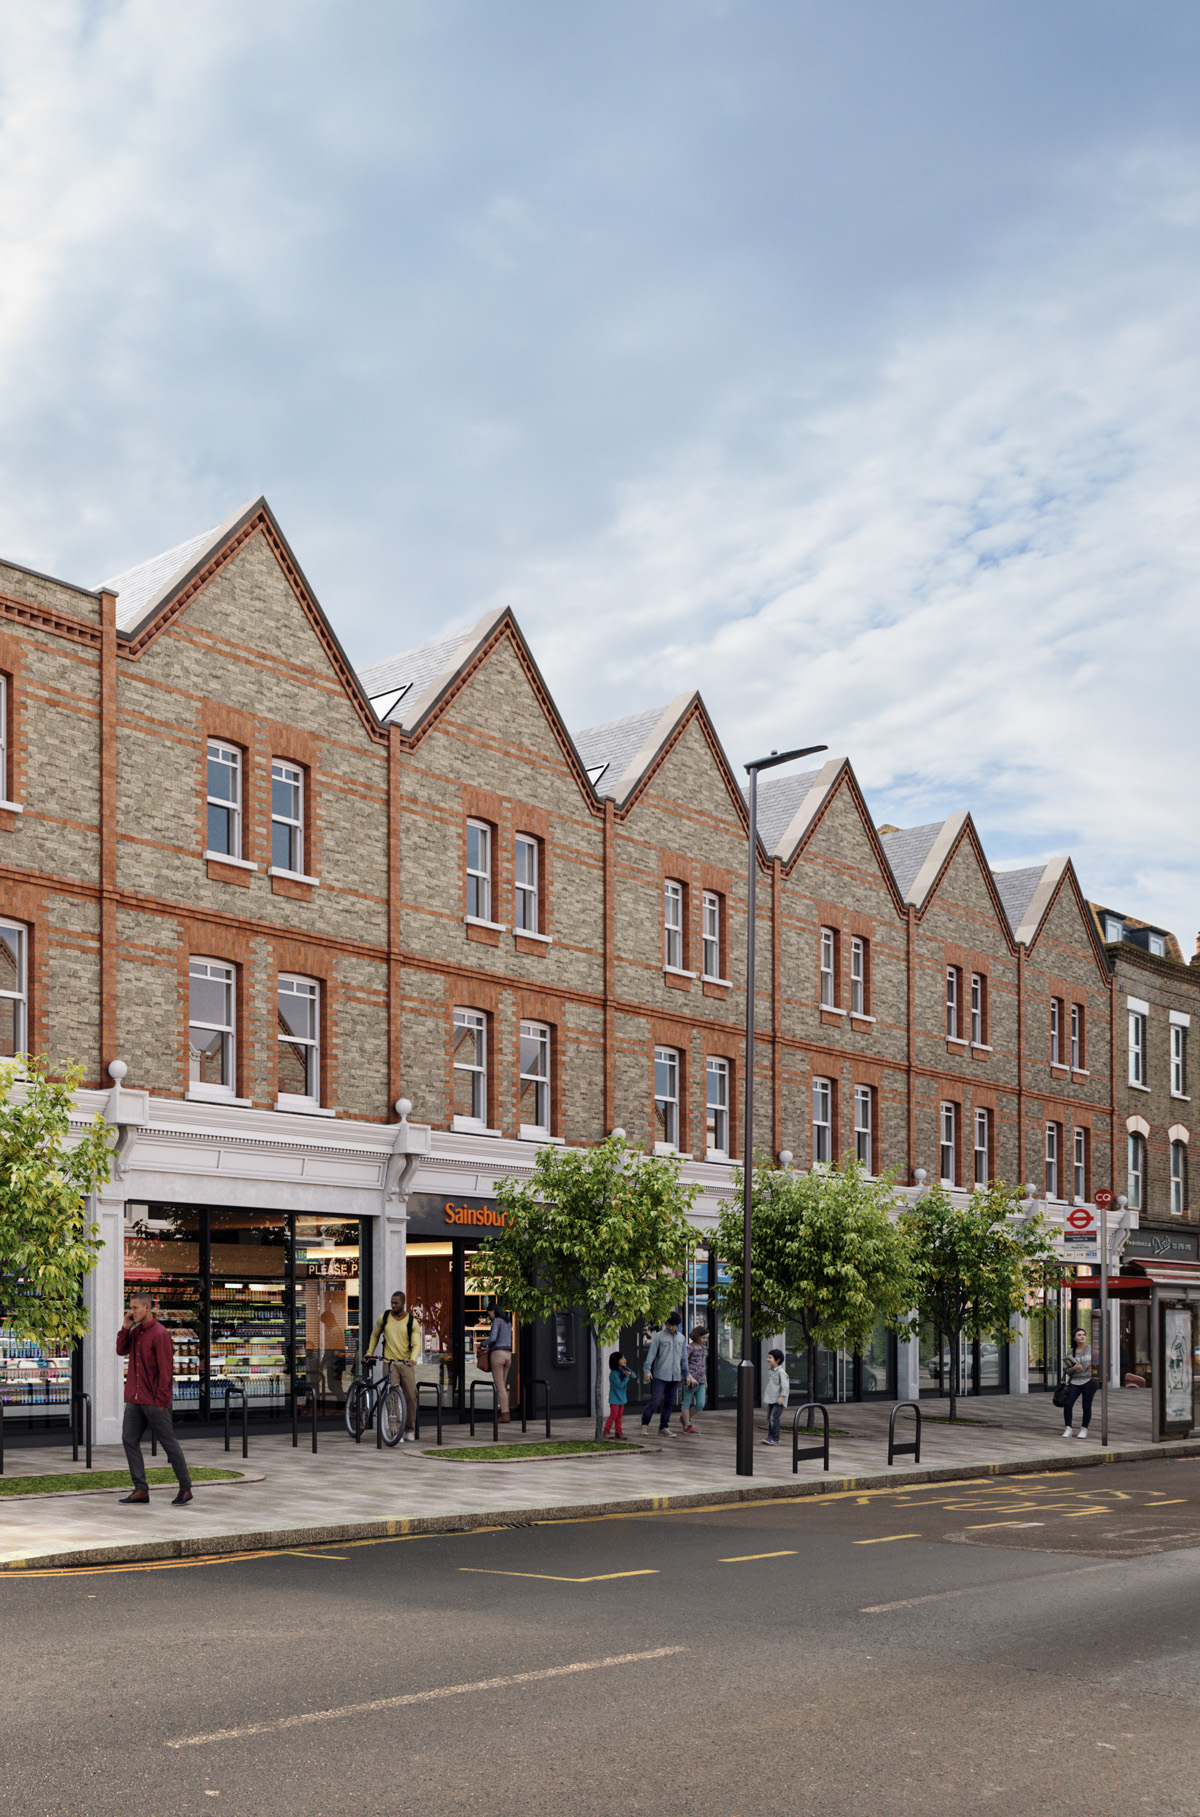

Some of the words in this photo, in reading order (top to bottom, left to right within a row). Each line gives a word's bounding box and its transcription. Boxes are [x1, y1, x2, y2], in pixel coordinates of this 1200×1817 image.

[1095, 1193, 1111, 1202] CQ
[444, 1202, 520, 1231] Sainsbur
[308, 1264, 348, 1276] PLEASE
[351, 1264, 359, 1276] P
[963, 1485, 1167, 1501] BUS
